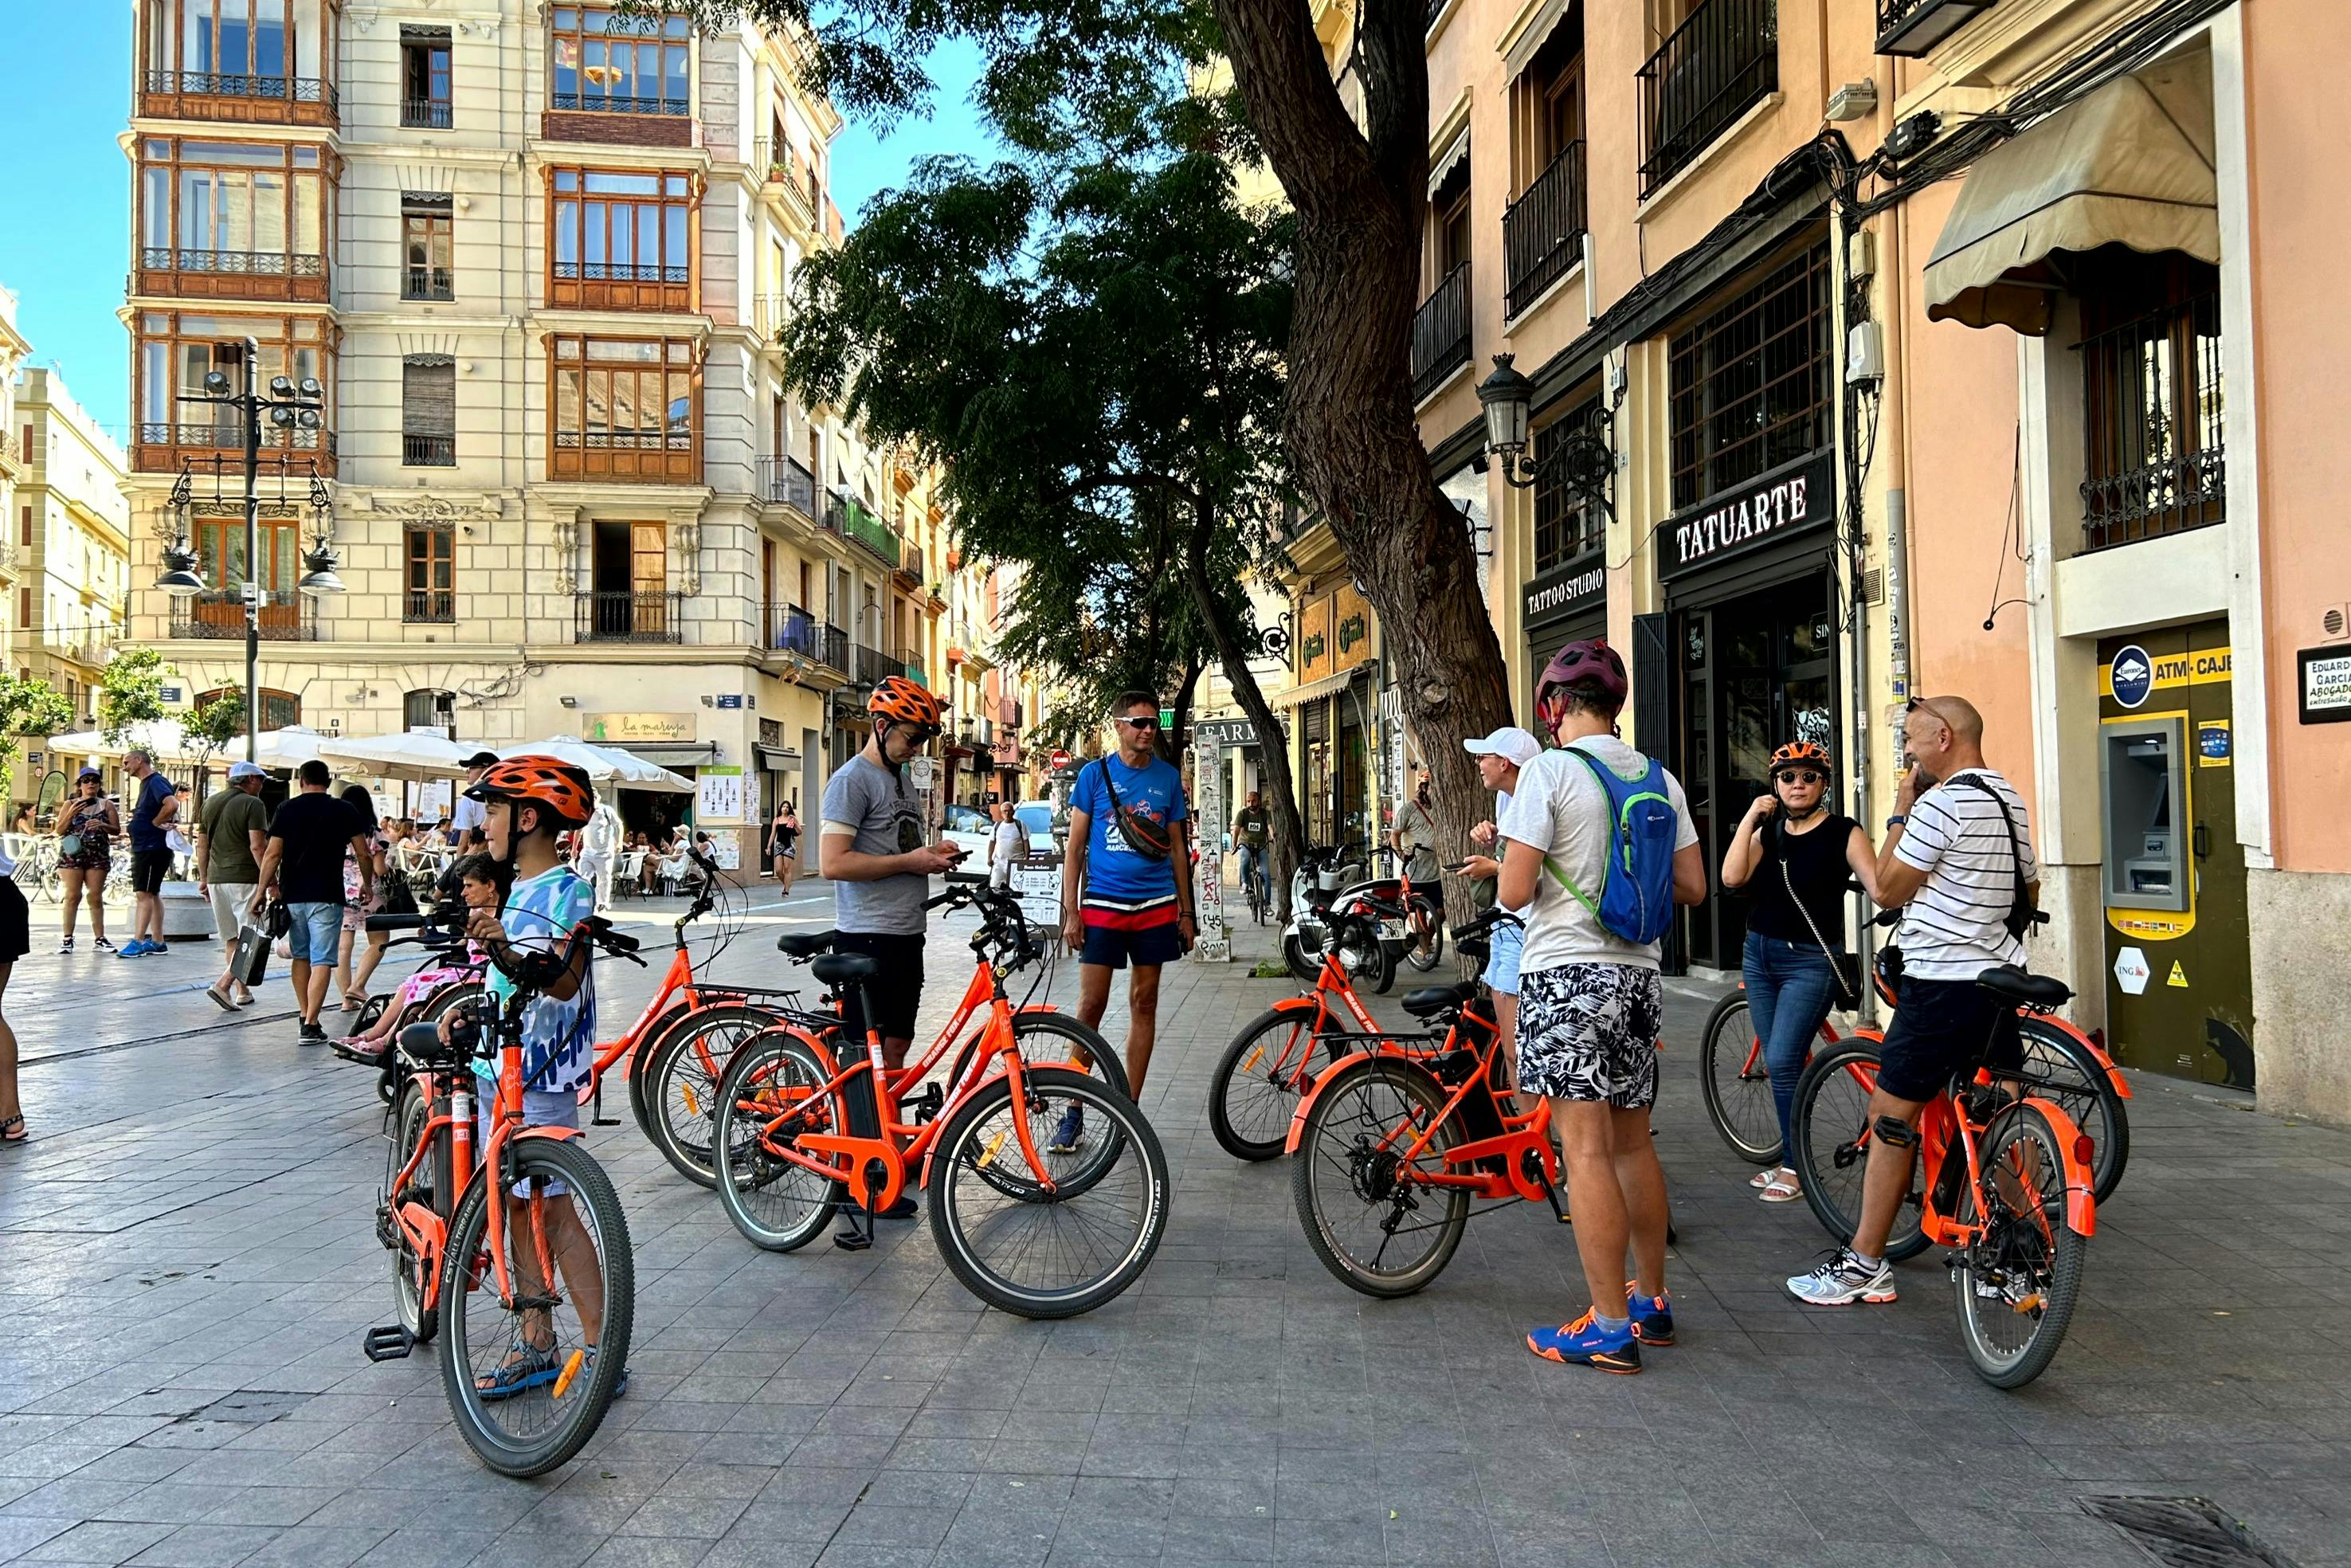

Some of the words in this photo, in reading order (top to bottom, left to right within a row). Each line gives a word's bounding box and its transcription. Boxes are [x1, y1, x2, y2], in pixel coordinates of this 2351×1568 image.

[1676, 475, 1807, 564] TATUARTE
[1528, 583, 1565, 614] TATTOO
[1566, 568, 1603, 600] STUDIO
[2120, 666, 2141, 675] Euronet
[2155, 661, 2188, 680] ATM
[2312, 661, 2351, 672] EDUARD
[621, 716, 637, 732] la
[641, 721, 687, 738] maruja
[922, 1035, 948, 1068] ORANGE
[445, 1259, 454, 1284] CST
[451, 1244, 460, 1259] ALL
[456, 1199, 476, 1241] TERRAINS
[1140, 1215, 1158, 1251] TERRAINS
